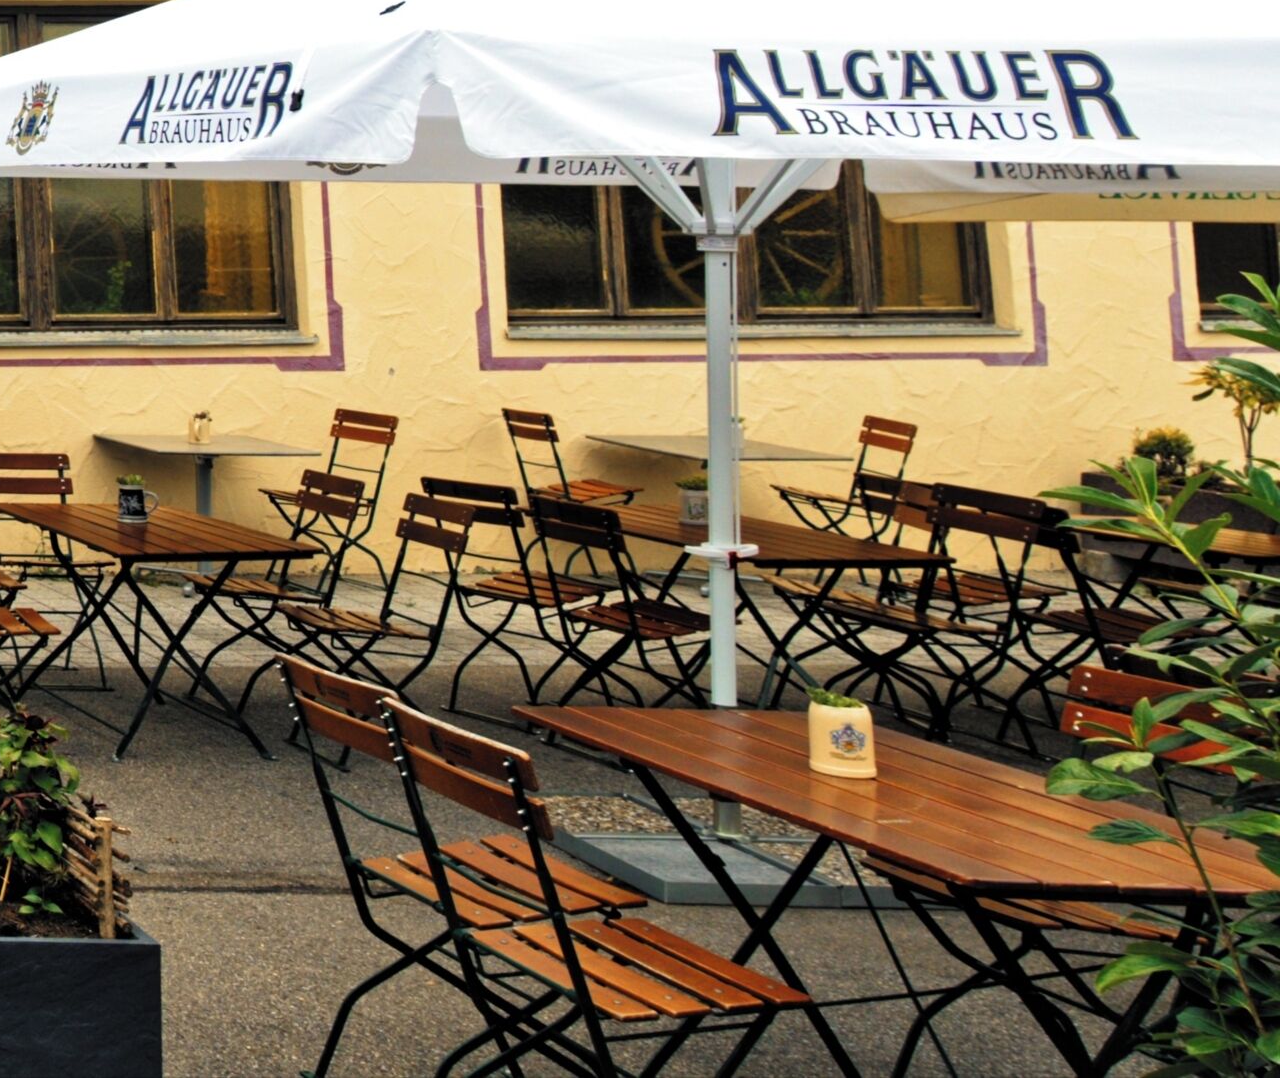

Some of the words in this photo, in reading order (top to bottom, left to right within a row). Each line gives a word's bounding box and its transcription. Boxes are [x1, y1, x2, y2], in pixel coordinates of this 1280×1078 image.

[118, 60, 294, 145] ALLGÄUER
[712, 48, 1140, 141] ALLGÄUER
[796, 107, 1059, 141] BRAUHAUS
[148, 117, 253, 144] BRAUHAUS
